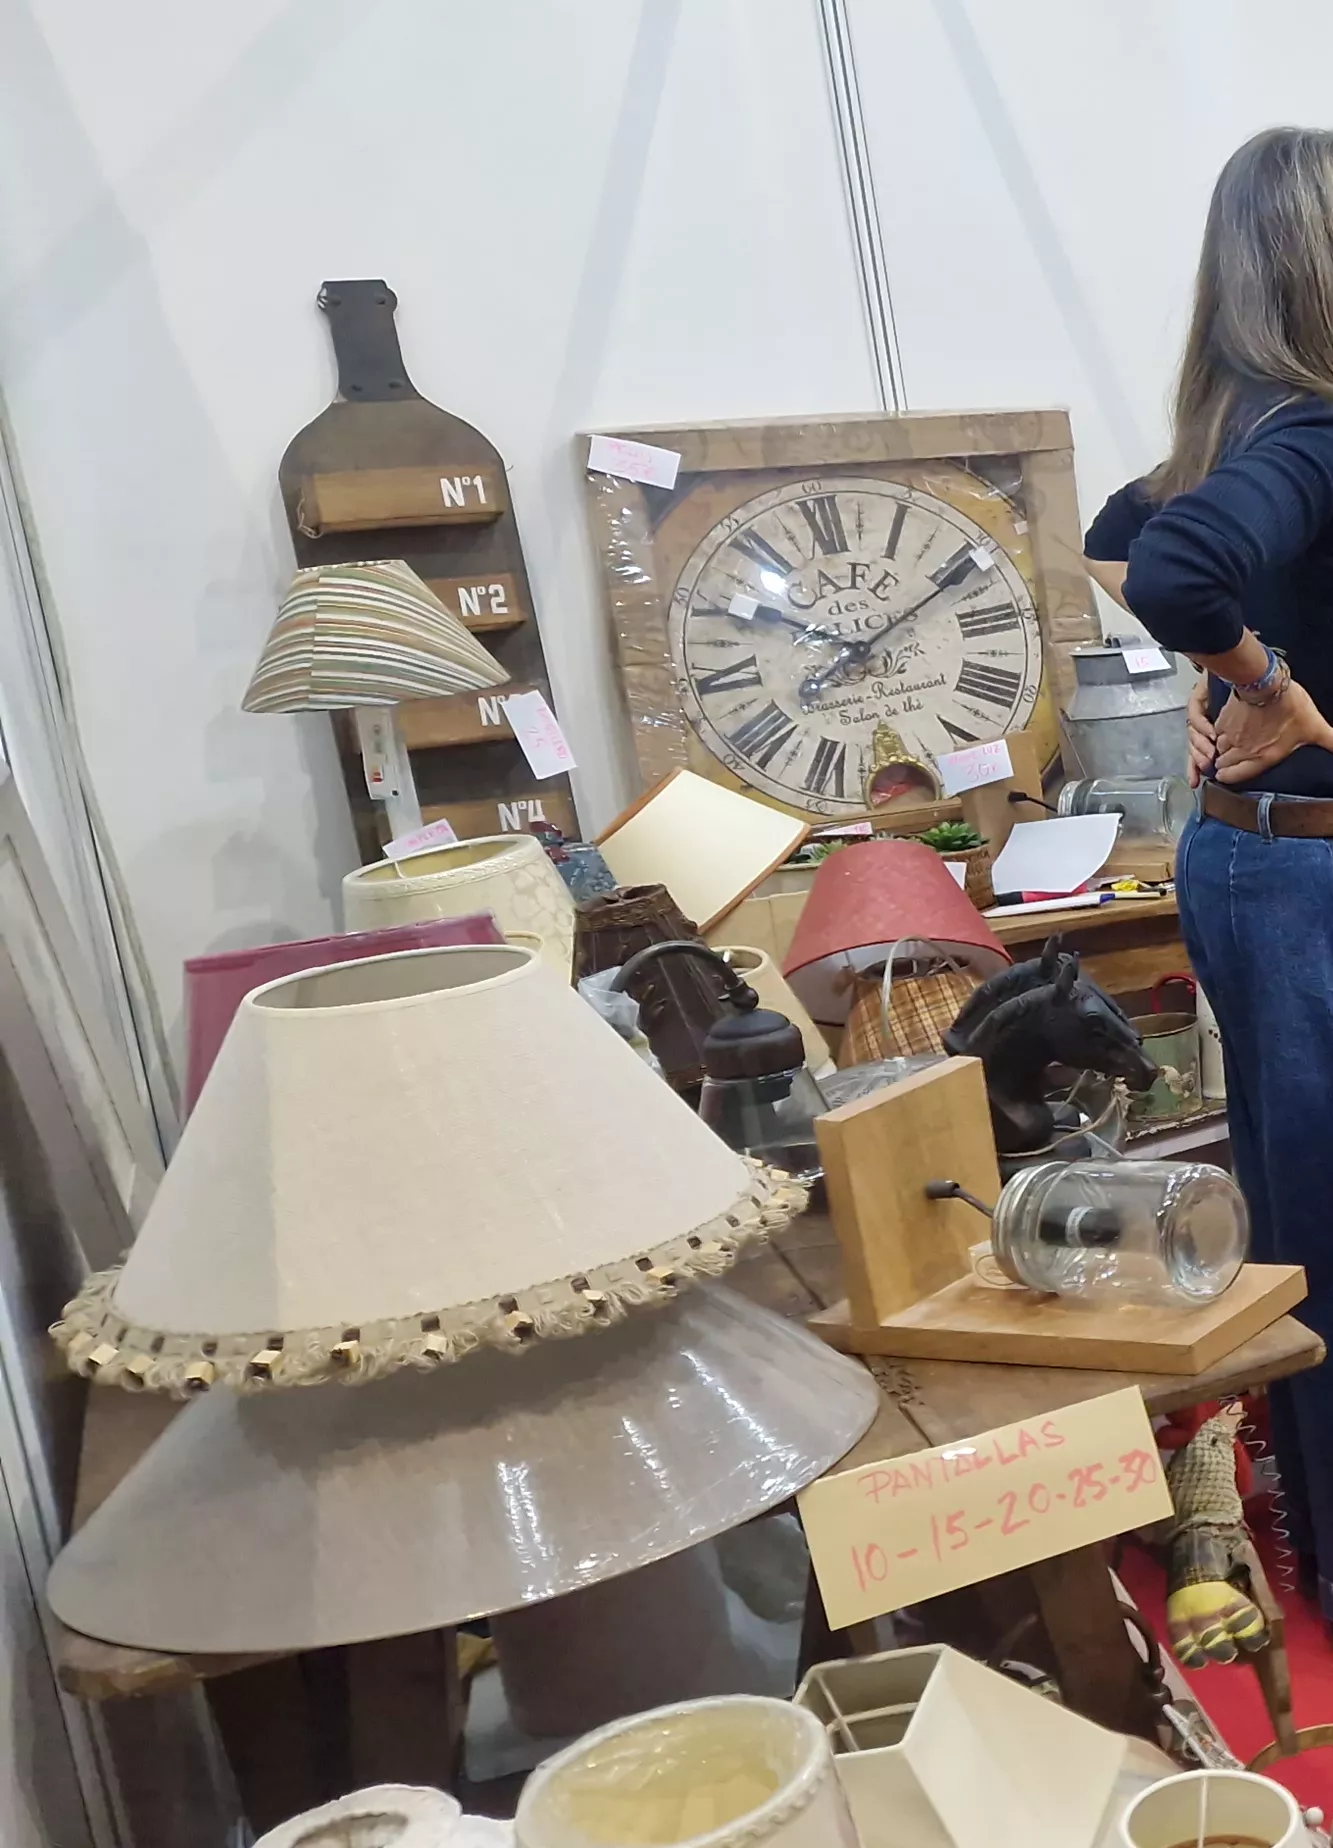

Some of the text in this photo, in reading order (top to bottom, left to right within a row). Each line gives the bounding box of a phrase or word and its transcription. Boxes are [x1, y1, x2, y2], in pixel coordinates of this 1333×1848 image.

[827, 599, 870, 616] des
[840, 708, 880, 727] Salon
[884, 704, 899, 718] de
[857, 1419, 1066, 1504] PANTALLAS
